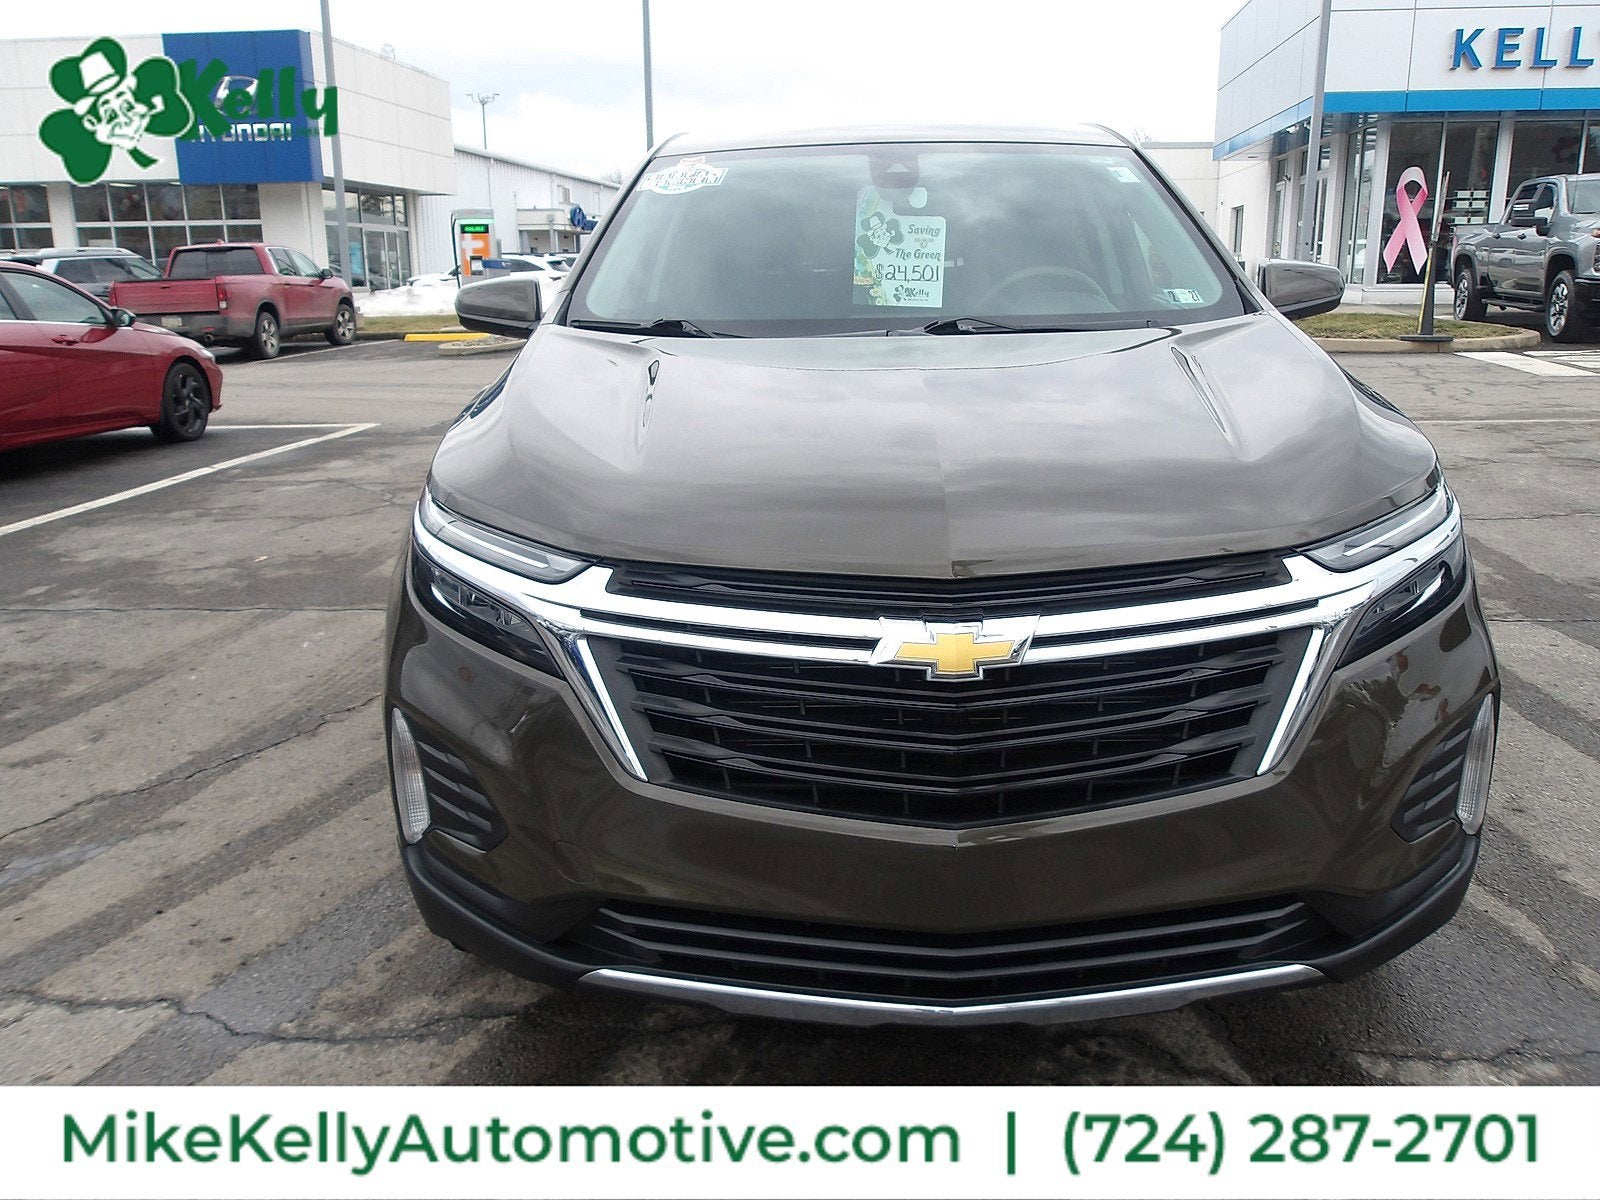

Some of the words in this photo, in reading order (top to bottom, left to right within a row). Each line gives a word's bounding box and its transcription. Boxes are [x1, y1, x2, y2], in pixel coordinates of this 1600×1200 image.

[191, 123, 292, 143] UNDAI
[907, 224, 940, 237] Saving
[895, 248, 912, 261] The
[913, 248, 942, 262] Green
[909, 287, 930, 298] Kelly
